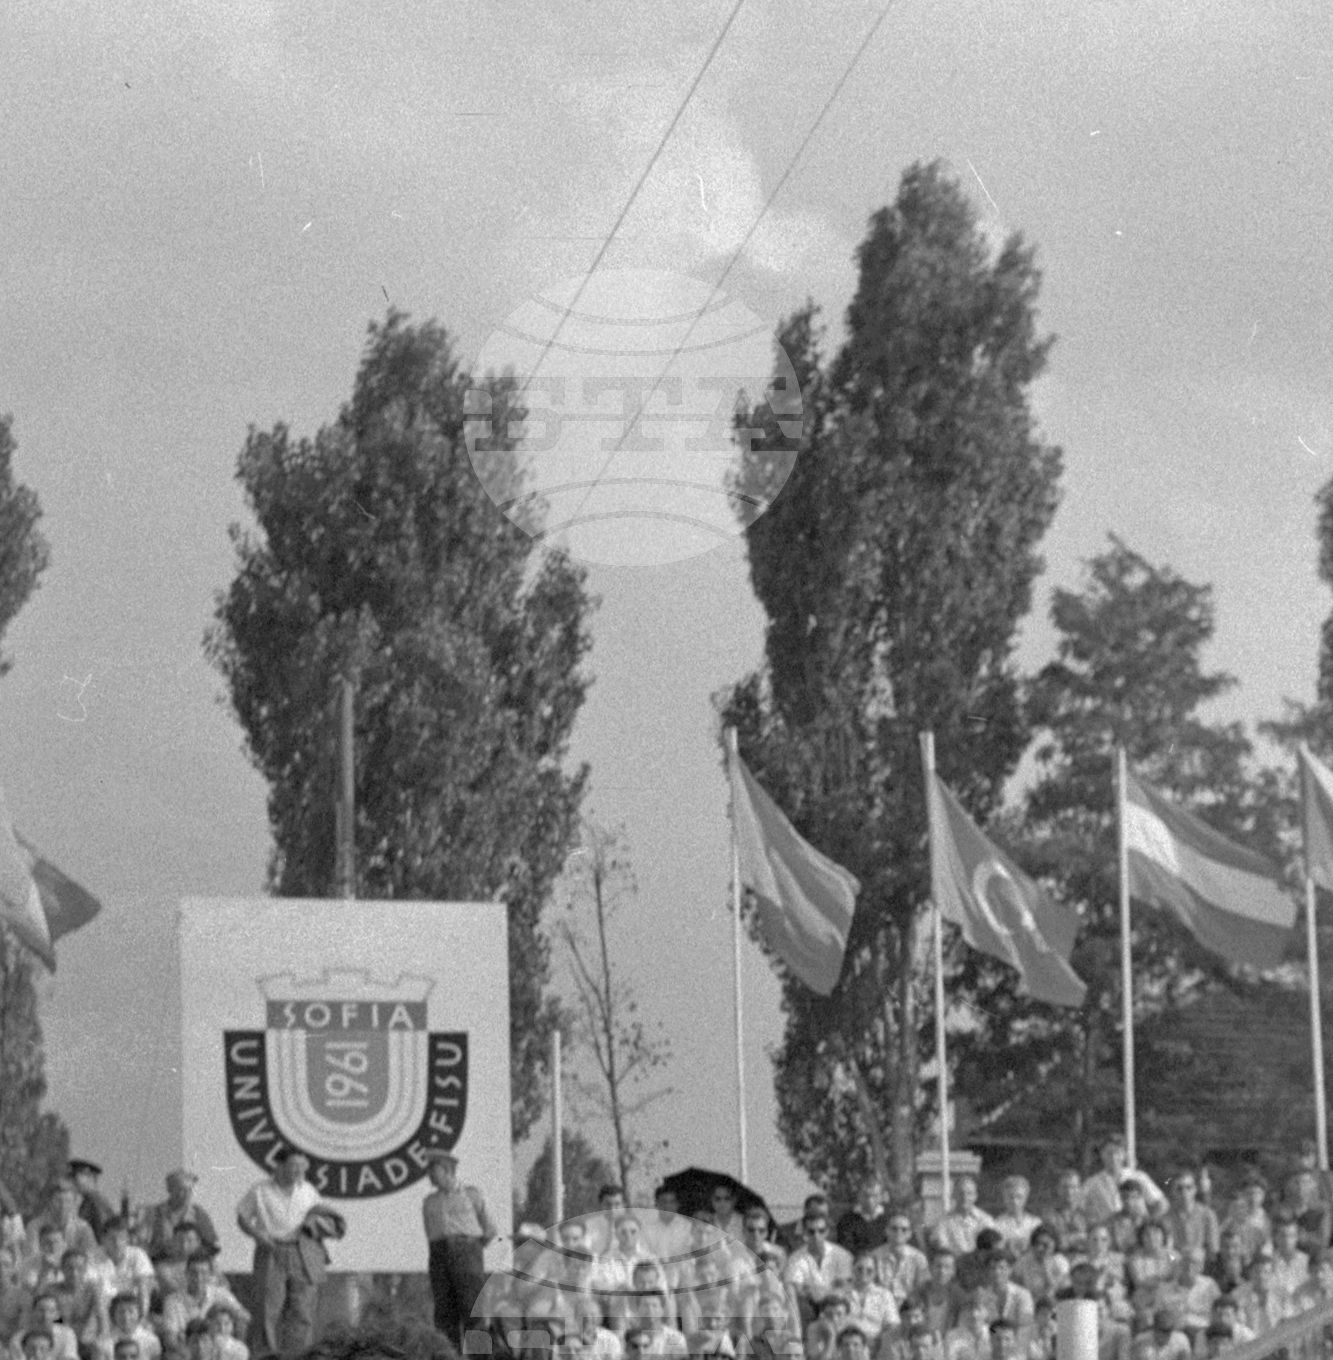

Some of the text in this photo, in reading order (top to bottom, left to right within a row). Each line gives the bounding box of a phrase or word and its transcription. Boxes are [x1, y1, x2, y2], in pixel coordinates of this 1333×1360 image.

[283, 1002, 414, 1029] SOFIA
[325, 1041, 369, 1107] 1961
[230, 1039, 462, 1194] UNIVESIADE FISU
